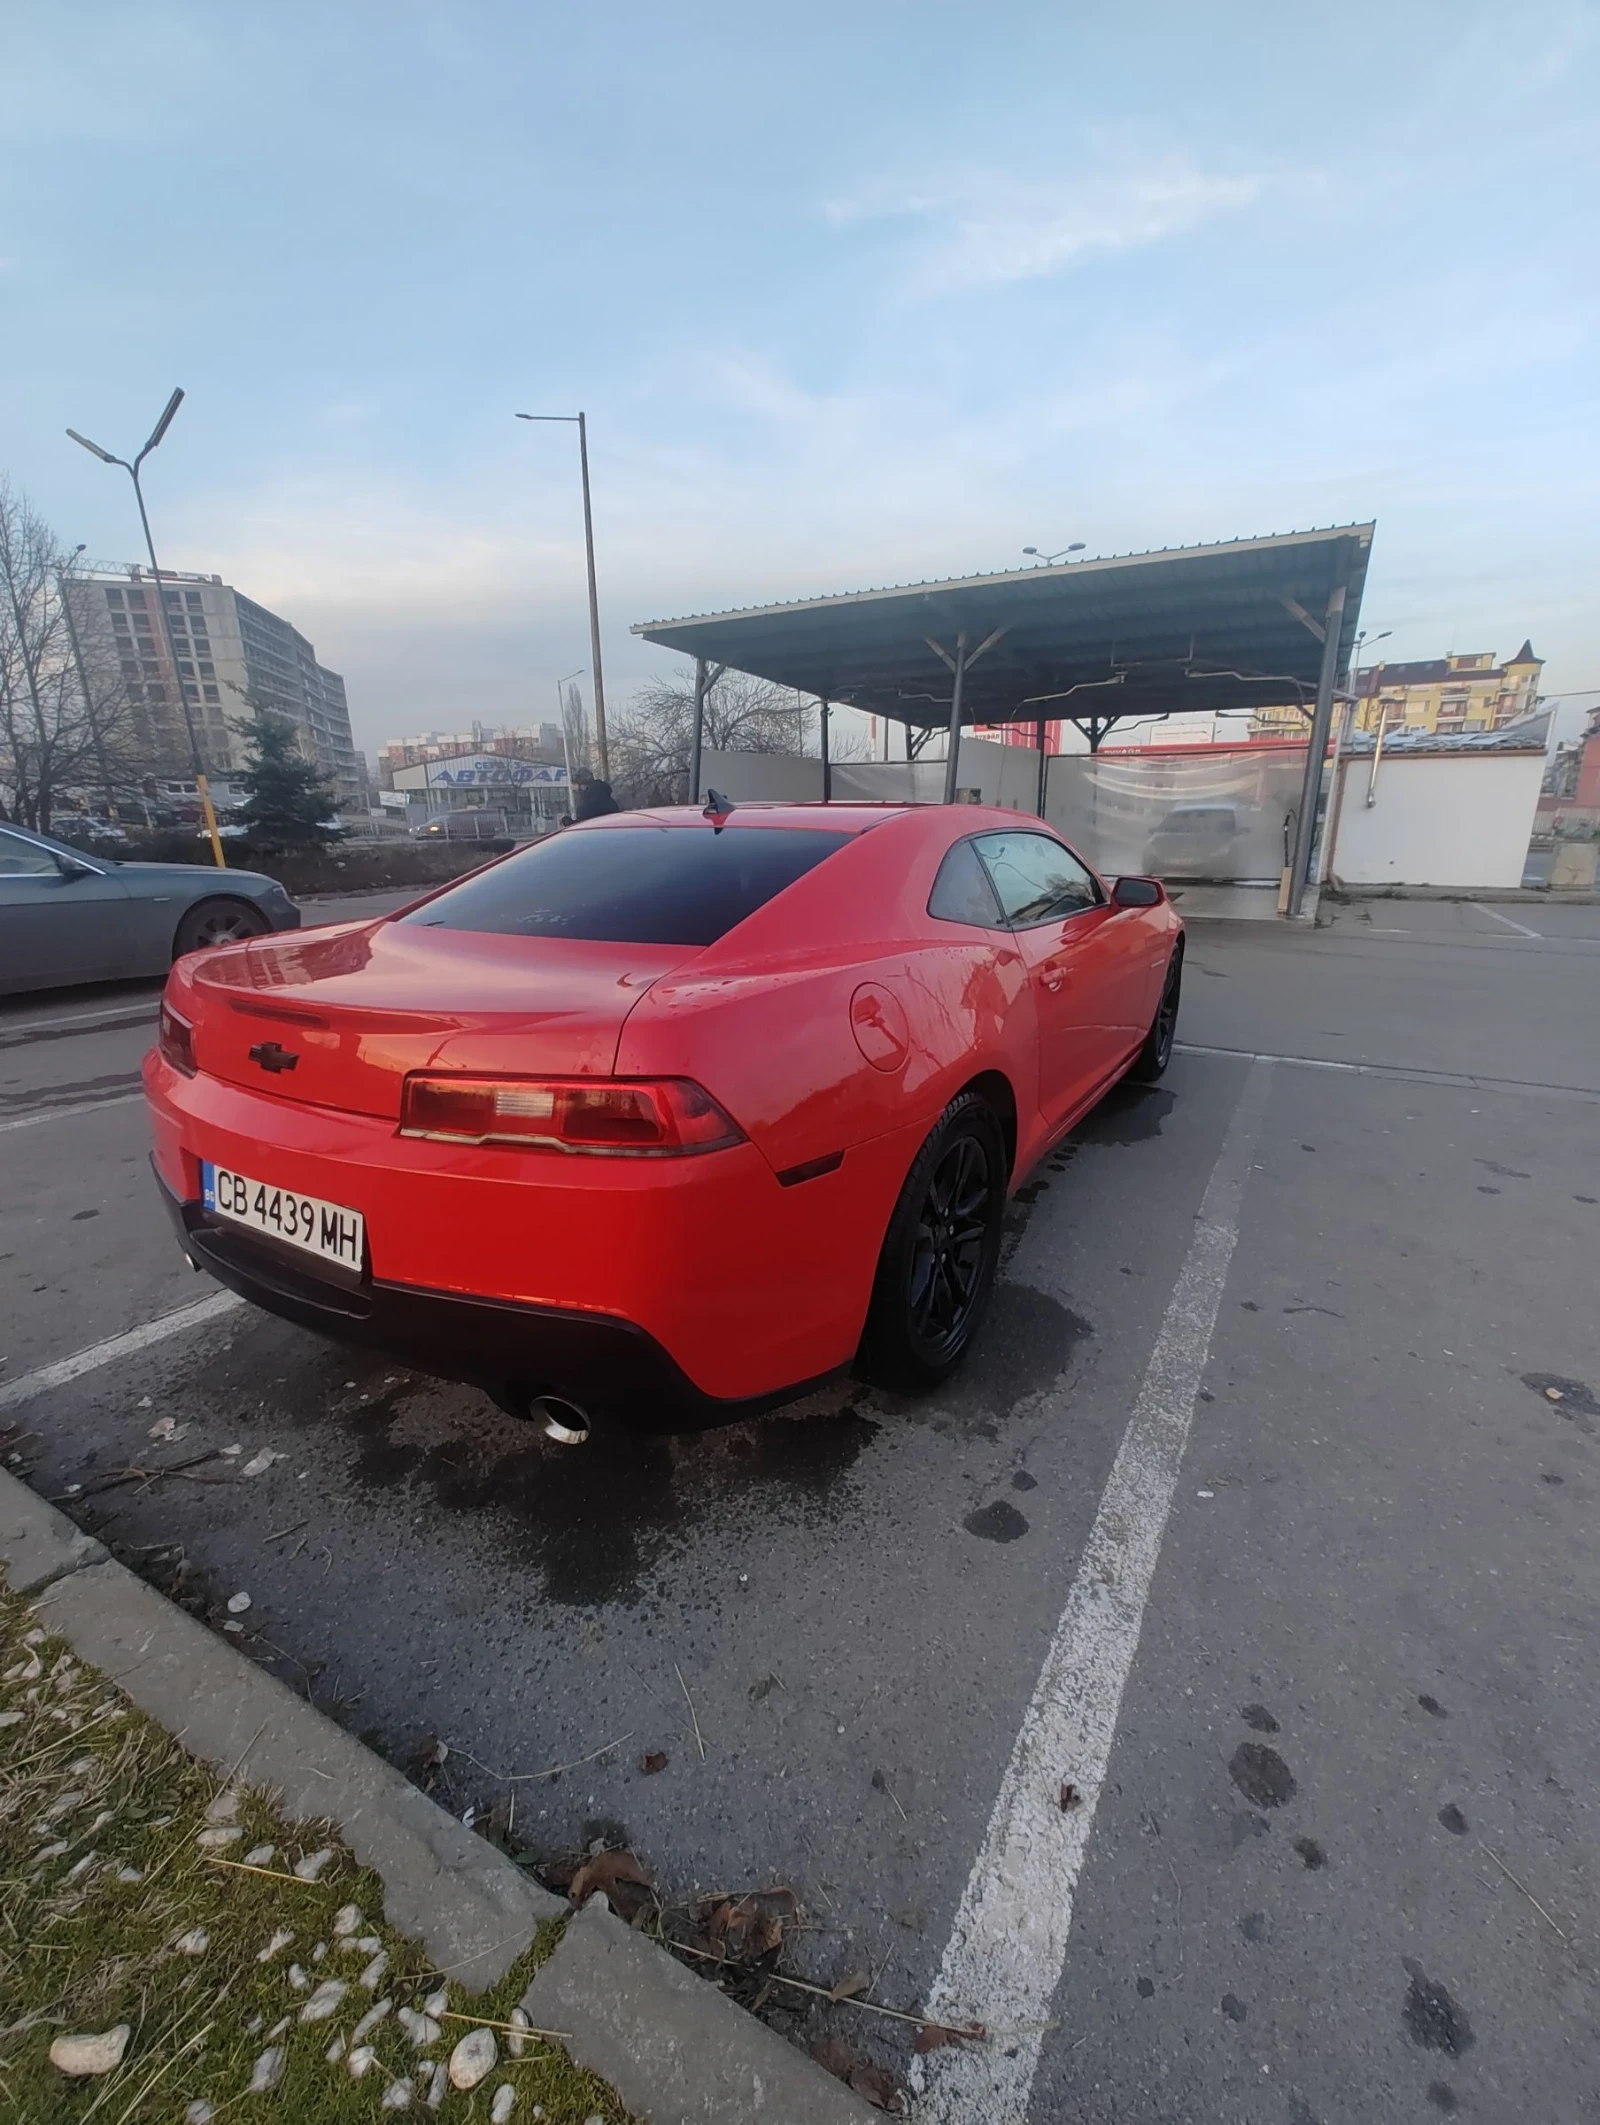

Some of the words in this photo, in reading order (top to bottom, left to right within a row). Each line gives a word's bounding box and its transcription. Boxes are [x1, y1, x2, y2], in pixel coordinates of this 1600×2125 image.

[218, 1170, 248, 1216] CB
[254, 1184, 316, 1243] 4439
[321, 1206, 357, 1262] MH
